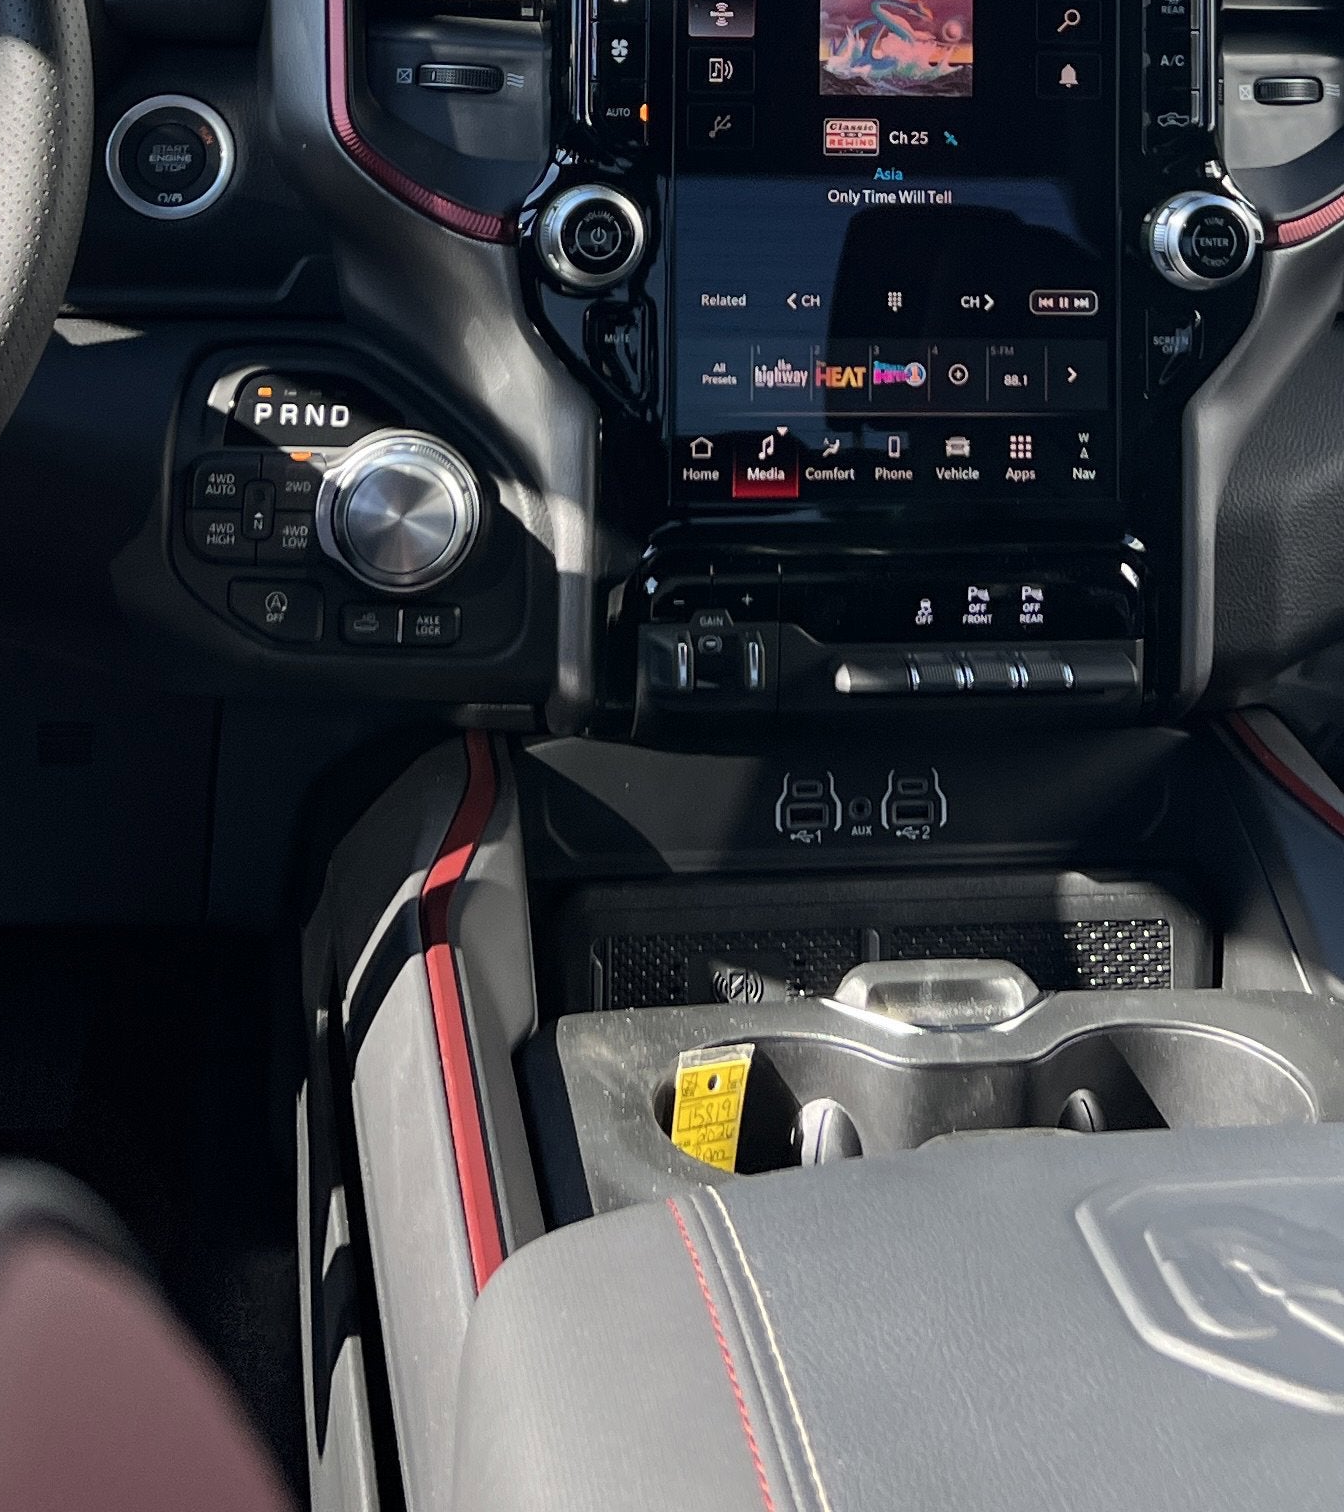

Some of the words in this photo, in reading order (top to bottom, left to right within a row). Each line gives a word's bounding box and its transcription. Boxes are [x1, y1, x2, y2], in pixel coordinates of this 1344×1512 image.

[1160, 5, 1186, 15] REAR
[1159, 54, 1186, 67] A/C
[605, 107, 632, 118] AUTO
[828, 121, 876, 133] Classic
[828, 138, 875, 148] REWIND
[888, 130, 908, 146] Ch
[909, 130, 930, 146] 25
[151, 143, 191, 154] START
[148, 153, 194, 164] ENGINE
[154, 163, 188, 174] STOP
[872, 167, 905, 182] Asia
[827, 189, 861, 207] Only
[862, 189, 897, 205] Time
[898, 189, 927, 205] Will
[926, 189, 954, 205] Tell
[582, 209, 616, 224] VOLUME
[1203, 215, 1226, 228] TUNE
[1198, 236, 1230, 248] ENTER
[1201, 255, 1230, 268] SCROLL
[700, 292, 748, 308] Related
[800, 293, 822, 309] CH
[959, 294, 982, 310] CH
[603, 333, 631, 344] MUTE
[872, 344, 881, 356] 3
[931, 344, 940, 356] 4
[712, 361, 727, 374] All
[701, 373, 738, 387] Presets
[754, 364, 809, 389] highway
[815, 365, 868, 389] HEAT
[1003, 373, 1029, 388] 88.1
[1077, 431, 1091, 445] W
[207, 472, 236, 486] 4WD
[682, 467, 720, 482] Home
[746, 466, 786, 482] Media
[804, 466, 856, 482] Comfort
[873, 466, 914, 482] Phone
[935, 466, 981, 481] Vehicle
[1004, 466, 1037, 483] Apps
[1071, 466, 1097, 481] Nav
[204, 483, 237, 497] AUTO
[284, 480, 312, 494] 2WD
[207, 521, 236, 535] 4WD
[252, 518, 264, 531] N
[281, 524, 310, 537] 4WD
[205, 532, 236, 546] HIGH
[281, 536, 309, 550] LOW
[967, 602, 988, 614] OFF
[1021, 602, 1042, 614] OFF
[265, 612, 285, 624] OFF
[416, 614, 442, 626] AXLE
[698, 615, 725, 628] GAIN
[914, 613, 935, 626] OFF
[961, 613, 994, 625] FRONT
[1018, 613, 1045, 625] REAR
[414, 623, 443, 637] LOCK
[814, 829, 823, 845] 1
[850, 824, 873, 837] AUX
[921, 824, 931, 841] 2
